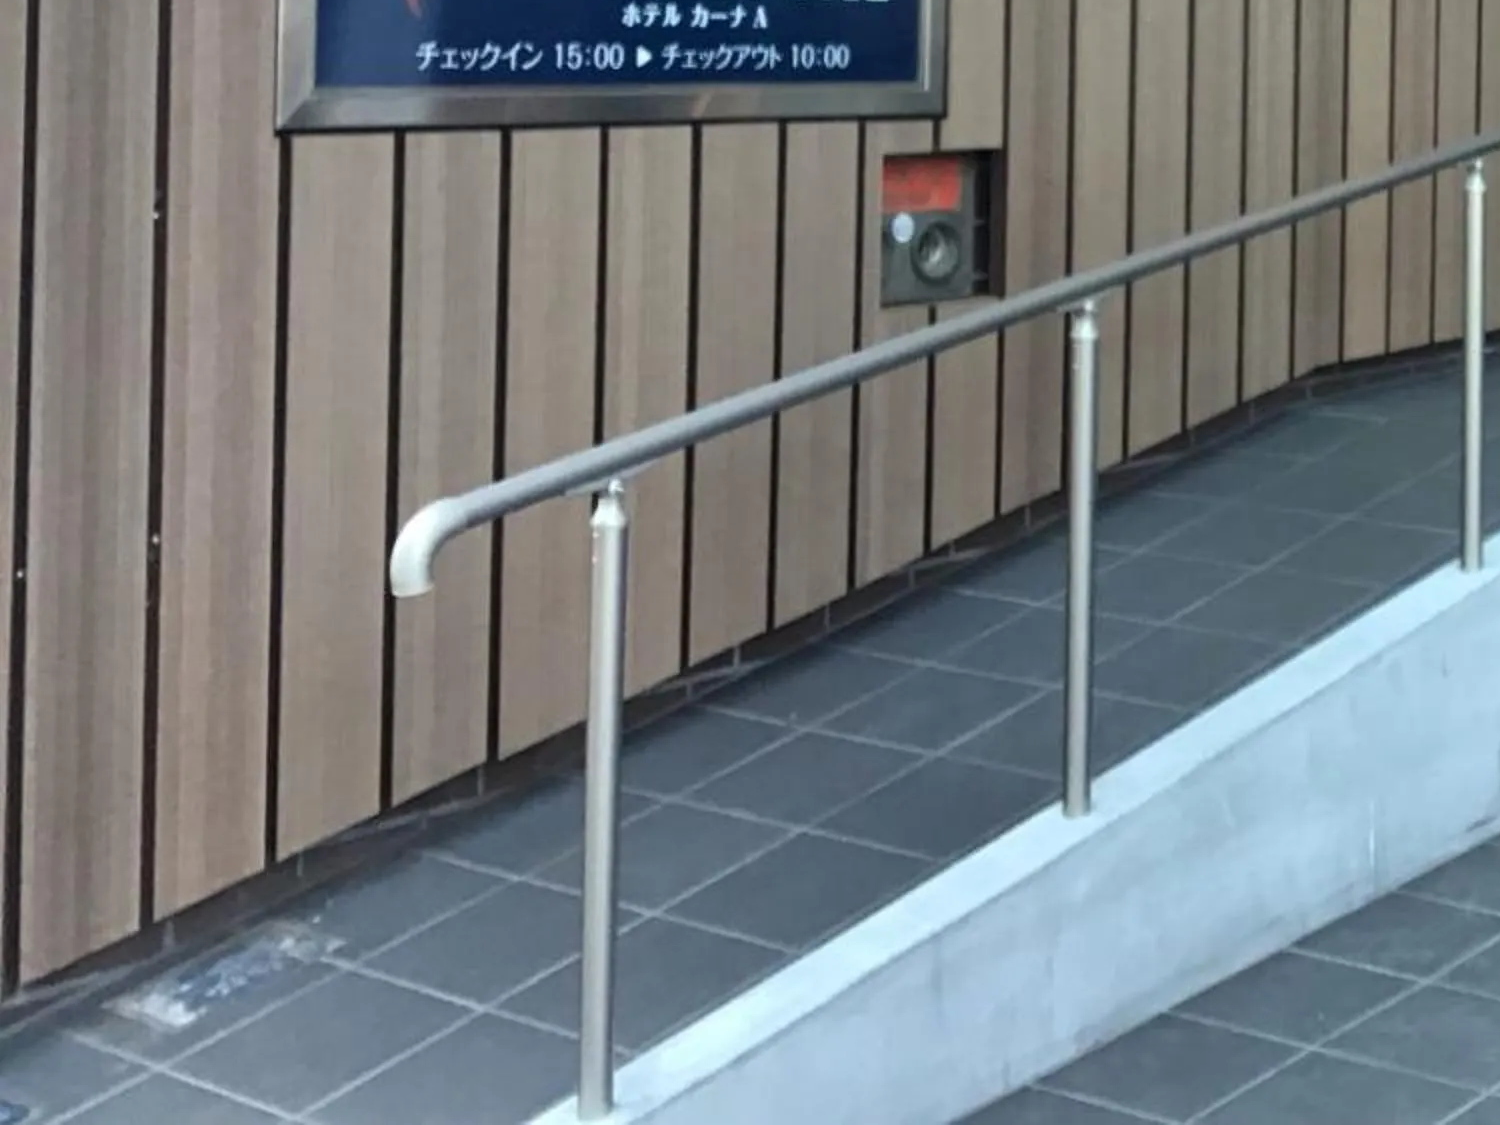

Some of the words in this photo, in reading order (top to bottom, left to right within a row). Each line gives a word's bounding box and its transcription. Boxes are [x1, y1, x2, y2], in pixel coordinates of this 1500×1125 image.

[621, 3, 682, 29] ホテル
[752, 5, 768, 30] A
[416, 41, 543, 71] チェックイン
[554, 43, 625, 70] 15:00
[661, 43, 782, 71] チェックアウト
[790, 43, 851, 70] 10:00
